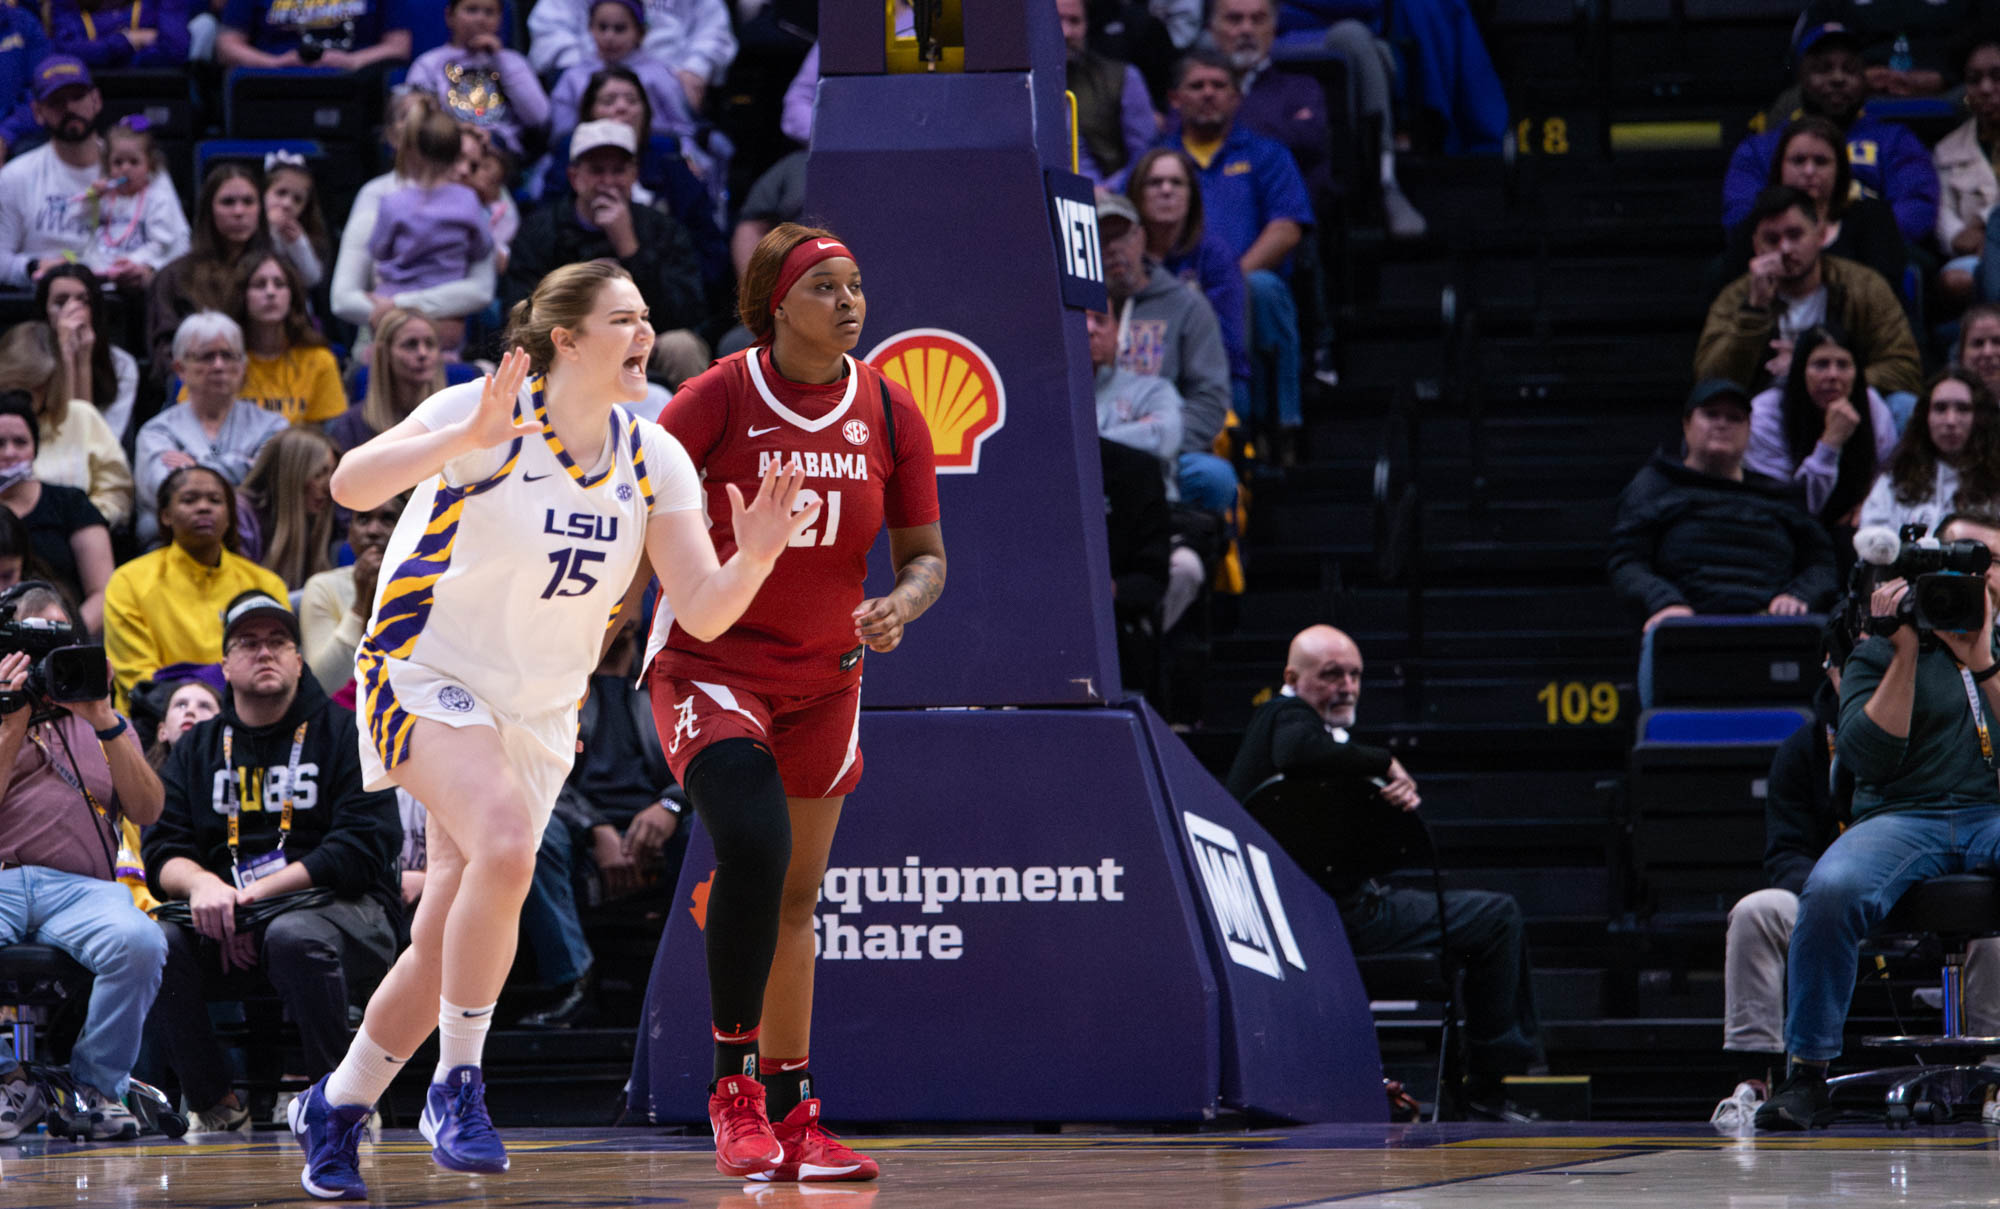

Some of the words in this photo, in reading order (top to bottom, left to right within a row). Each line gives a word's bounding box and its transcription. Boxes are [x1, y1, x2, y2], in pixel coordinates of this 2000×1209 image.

[1055, 196, 1104, 283] YETI
[844, 421, 868, 443] SEC
[758, 450, 868, 480] ALABAMA
[543, 508, 619, 542] LSU
[788, 488, 841, 547] 21
[540, 547, 607, 600] 15
[1537, 681, 1619, 725] 109
[212, 762, 320, 815] CUBS
[817, 856, 1125, 913] quipment
